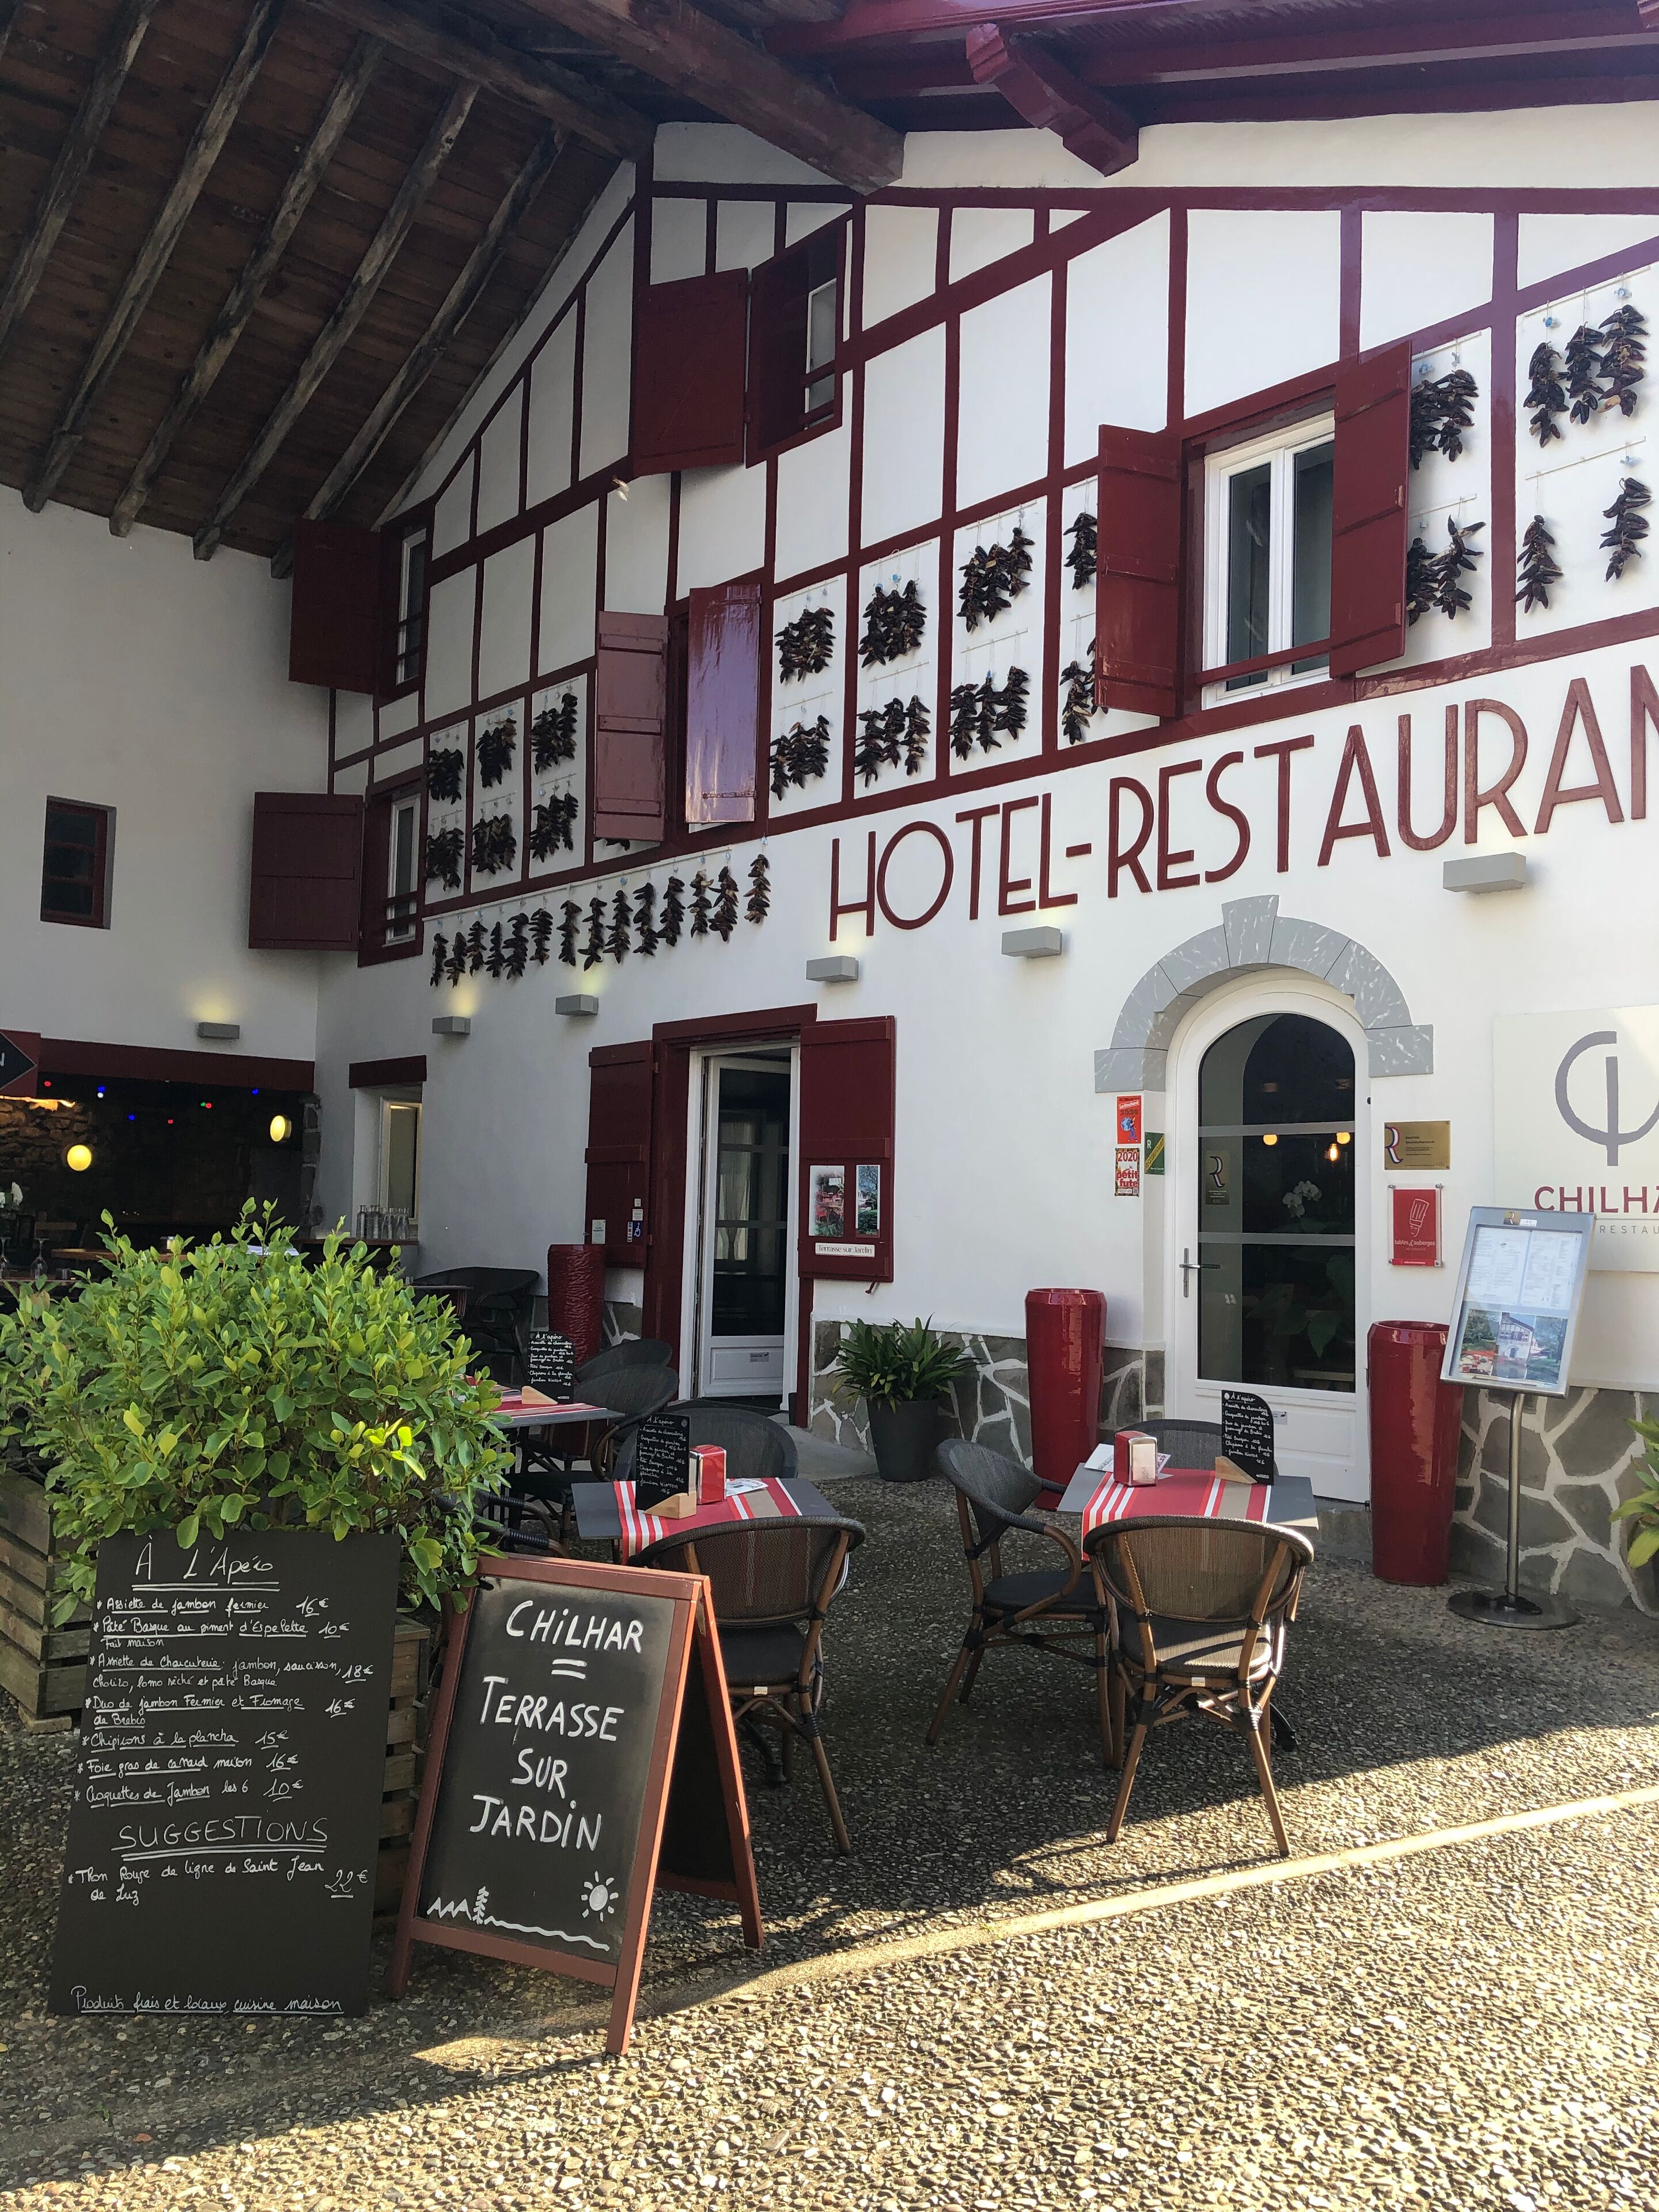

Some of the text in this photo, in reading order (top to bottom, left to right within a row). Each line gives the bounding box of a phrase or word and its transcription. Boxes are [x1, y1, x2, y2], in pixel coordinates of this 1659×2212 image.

[1118, 1151, 1138, 1162] 2020
[1116, 1169, 1139, 1180] petit
[818, 1244, 842, 1252] Terrasse
[135, 1535, 273, 1584] À L'Apéro
[107, 1596, 329, 1618] Assiette de jambon fermier 16€
[103, 1615, 127, 1633] Pâté
[131, 1617, 169, 1635] Basque
[177, 1623, 195, 1631] au
[201, 1620, 233, 1634] piment
[319, 1621, 350, 1635] 10€
[100, 1637, 164, 1650] Fait maison
[99, 1653, 135, 1667] Assiette
[140, 1656, 154, 1666] de
[342, 1665, 373, 1679] 18€
[137, 1675, 162, 1687] lomo
[197, 1676, 209, 1686] et
[244, 1675, 277, 1690] Basque
[93, 1694, 355, 1717] Duo de jambon Fermier et Fromage 16€
[478, 1676, 624, 1742] TERRASSE
[93, 1715, 108, 1725] de
[91, 1728, 289, 1751] Chipirons à la plancha 15€
[86, 1759, 112, 1773] Foie
[118, 1763, 140, 1778] gras
[145, 1759, 160, 1770] de
[214, 1756, 252, 1769] maison
[266, 1752, 298, 1768] 16€
[510, 1748, 567, 1798] SUR
[86, 1785, 139, 1806] Croquettes
[143, 1787, 162, 1800] de
[221, 1779, 237, 1794] les
[242, 1779, 249, 1793] 6
[263, 1778, 304, 1797] 10€
[111, 1816, 328, 1851] SUGGESTIONS
[75, 1866, 108, 1883] Thon
[161, 1865, 178, 1877] de
[185, 1859, 215, 1879] ligne
[242, 1858, 278, 1873] Saint
[287, 1855, 324, 1881] Jean
[324, 1869, 368, 1893] 22€
[90, 1888, 106, 1901] de
[70, 1985, 124, 2010] Produits
[133, 1991, 160, 2013] frais
[164, 1994, 180, 2010] et
[234, 1997, 276, 2010] cuisine
[284, 1995, 342, 2011] maison
